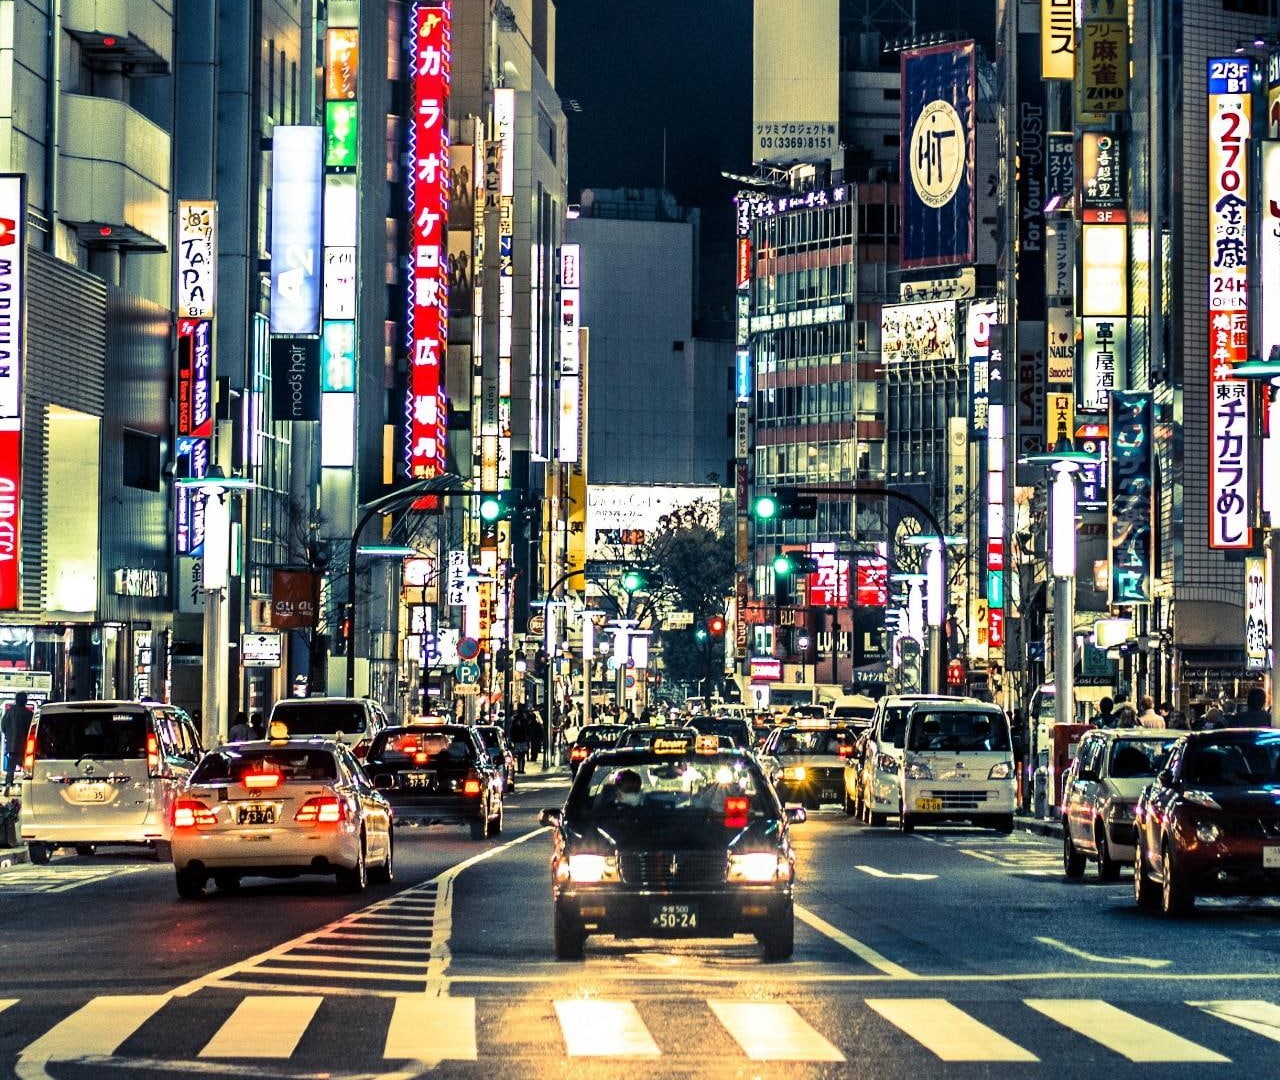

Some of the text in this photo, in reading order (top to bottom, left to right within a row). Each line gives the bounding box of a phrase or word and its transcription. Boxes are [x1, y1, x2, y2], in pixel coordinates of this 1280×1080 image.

[1090, 38, 1119, 87] 麻雀
[1086, 87, 1125, 102] ZOO
[1227, 79, 1249, 93] B1
[418, 44, 441, 235] カラオケ
[760, 136, 833, 151] 03(3369)8151
[1221, 113, 1243, 192] 270
[1096, 210, 1113, 223] 3F
[1213, 193, 1248, 268] 金の蔵
[1213, 276, 1248, 293] 24H
[188, 306, 207, 317] 8F
[1049, 345, 1074, 359] NAILS
[1095, 321, 1115, 406] 富士屋酒店
[1020, 353, 1036, 427] LABI
[1035, 350, 1044, 427] SHIBUYA
[1216, 384, 1246, 400] 東京
[1216, 398, 1246, 543] チカラめし
[816, 631, 848, 652] LUH
[660, 913, 697, 928] 50-24
